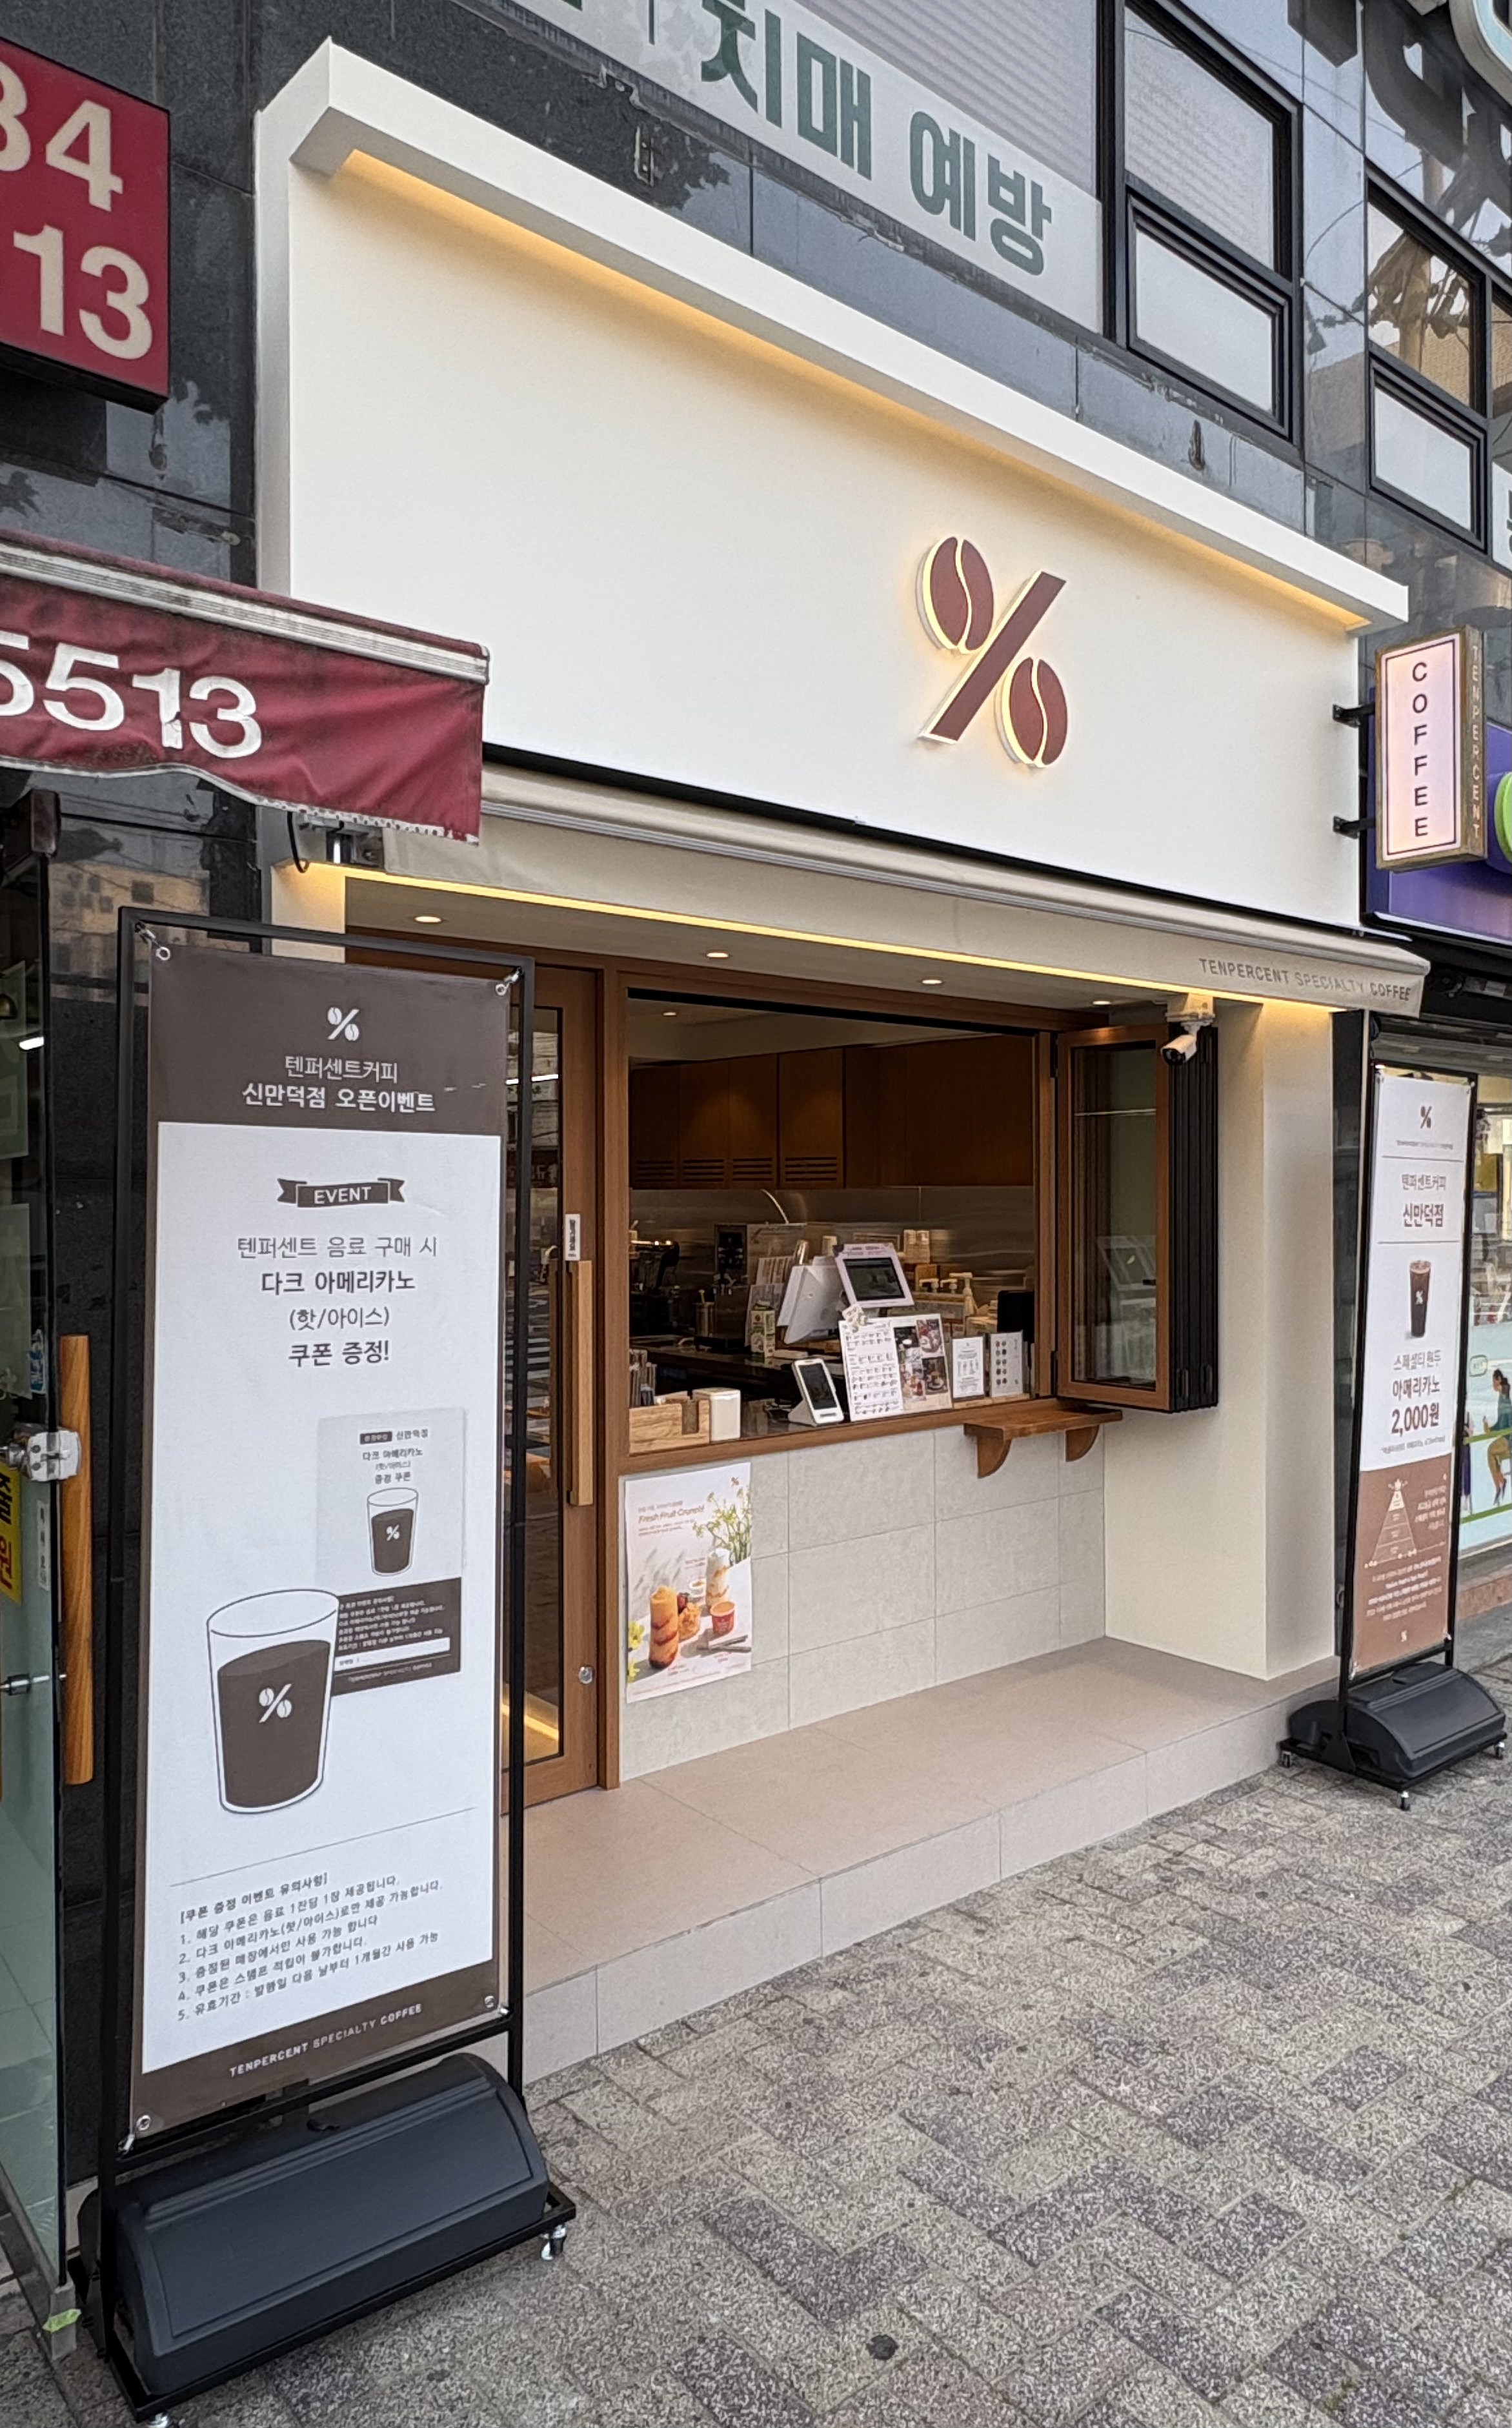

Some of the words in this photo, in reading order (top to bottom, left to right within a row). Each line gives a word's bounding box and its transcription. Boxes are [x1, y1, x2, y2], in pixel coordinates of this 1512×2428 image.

[701, 0, 872, 181] 치매
[909, 111, 1052, 276] 예방
[1411, 662, 1429, 838] COFFEE
[1472, 645, 1480, 838] TENPERCENT
[1198, 958, 1289, 984] TENPERCENT
[1295, 971, 1364, 993] SPECIALTY
[1369, 982, 1412, 1002] COFFEE
[284, 1055, 398, 1084] 텐퍼센트커피
[242, 1082, 326, 1109] 신만덕점
[335, 1089, 436, 1113] 오픈이벤트
[314, 1186, 372, 1204] EVENT
[1403, 1200, 1444, 1228] 신만덕점
[237, 1237, 318, 1259] 텐퍼센트
[327, 1237, 367, 1258] 음료
[374, 1237, 412, 1257] 구매
[419, 1237, 438, 1257] 시
[261, 1272, 305, 1295] 다크
[315, 1270, 416, 1294] 아메리카노
[289, 1306, 390, 1331] (핫/아이스)
[288, 1342, 334, 1367] 쿠폰
[342, 1340, 390, 1364] 증정!
[1393, 1374, 1440, 1401] 아메리카노
[1391, 1402, 1439, 1437] 2,000원
[196, 1943, 218, 1958] 다크
[229, 2041, 308, 2078] TENPERCENT
[313, 2019, 377, 2049] SPECIALTY
[380, 2003, 422, 2026] COFFEE
